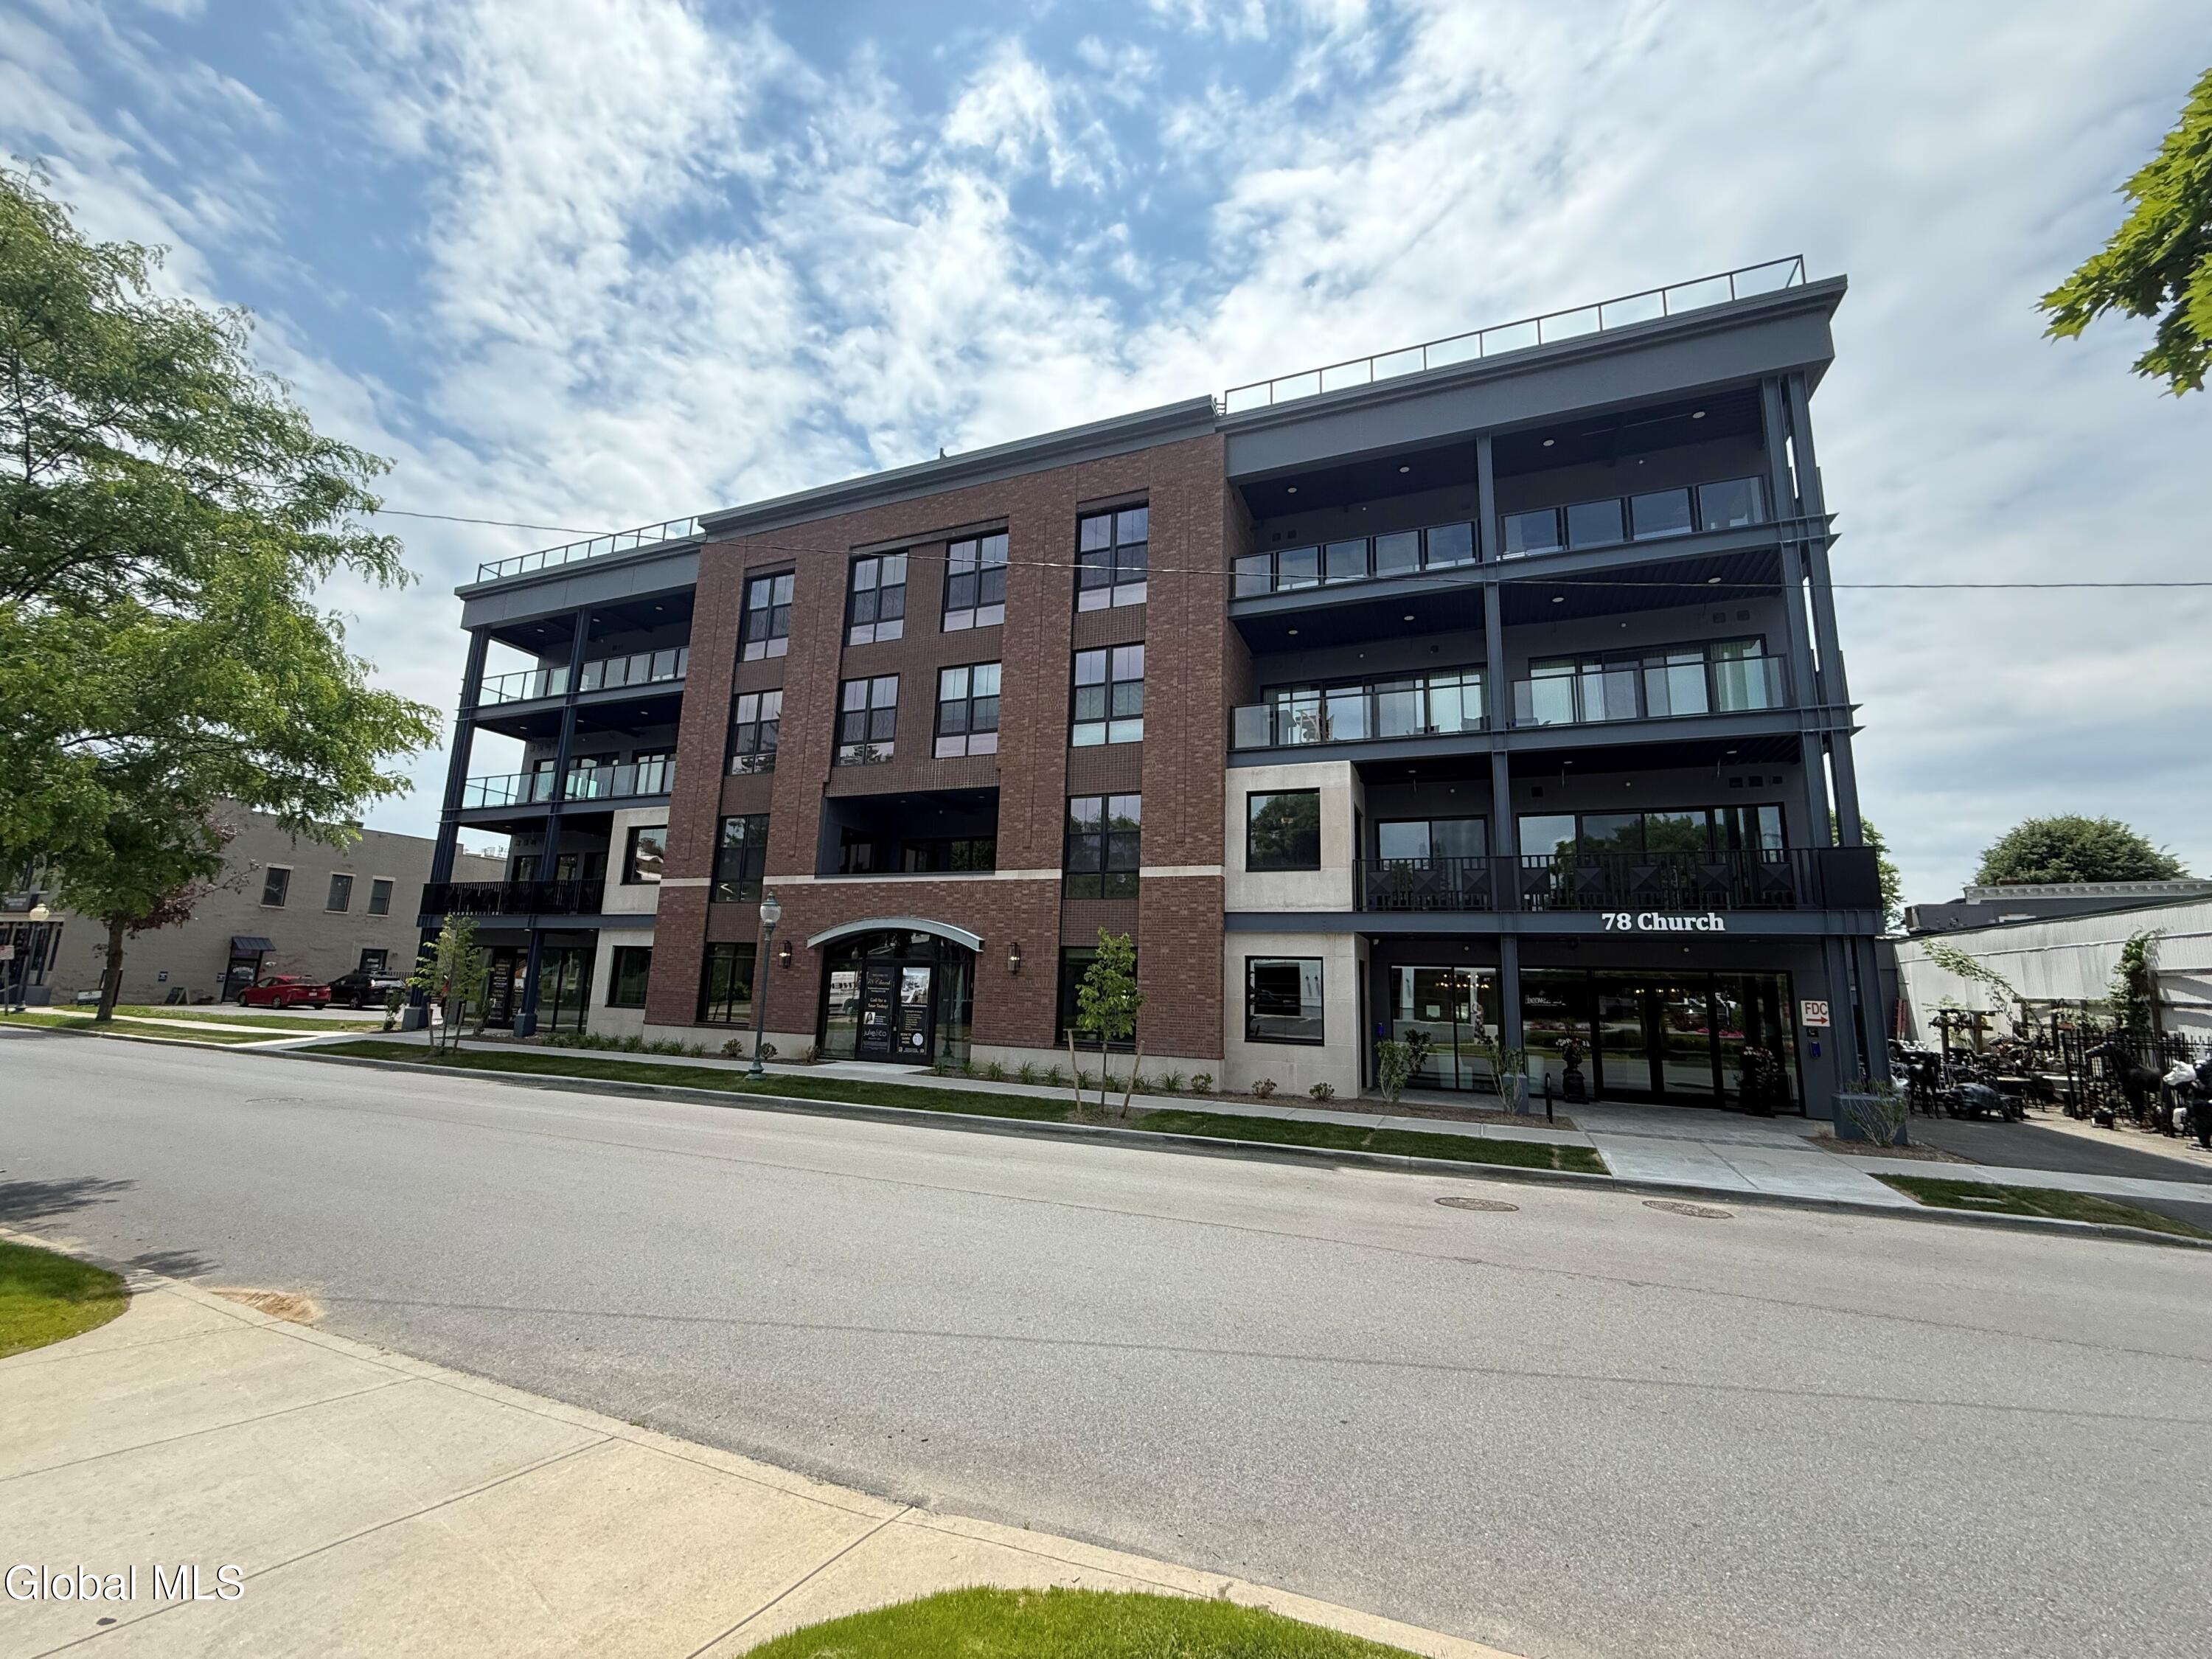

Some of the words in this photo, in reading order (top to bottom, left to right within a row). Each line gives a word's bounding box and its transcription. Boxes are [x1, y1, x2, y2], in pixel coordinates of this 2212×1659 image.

[1601, 913, 1632, 931] 78
[1637, 912, 1725, 931] Church
[1805, 1002, 1828, 1015] FDC
